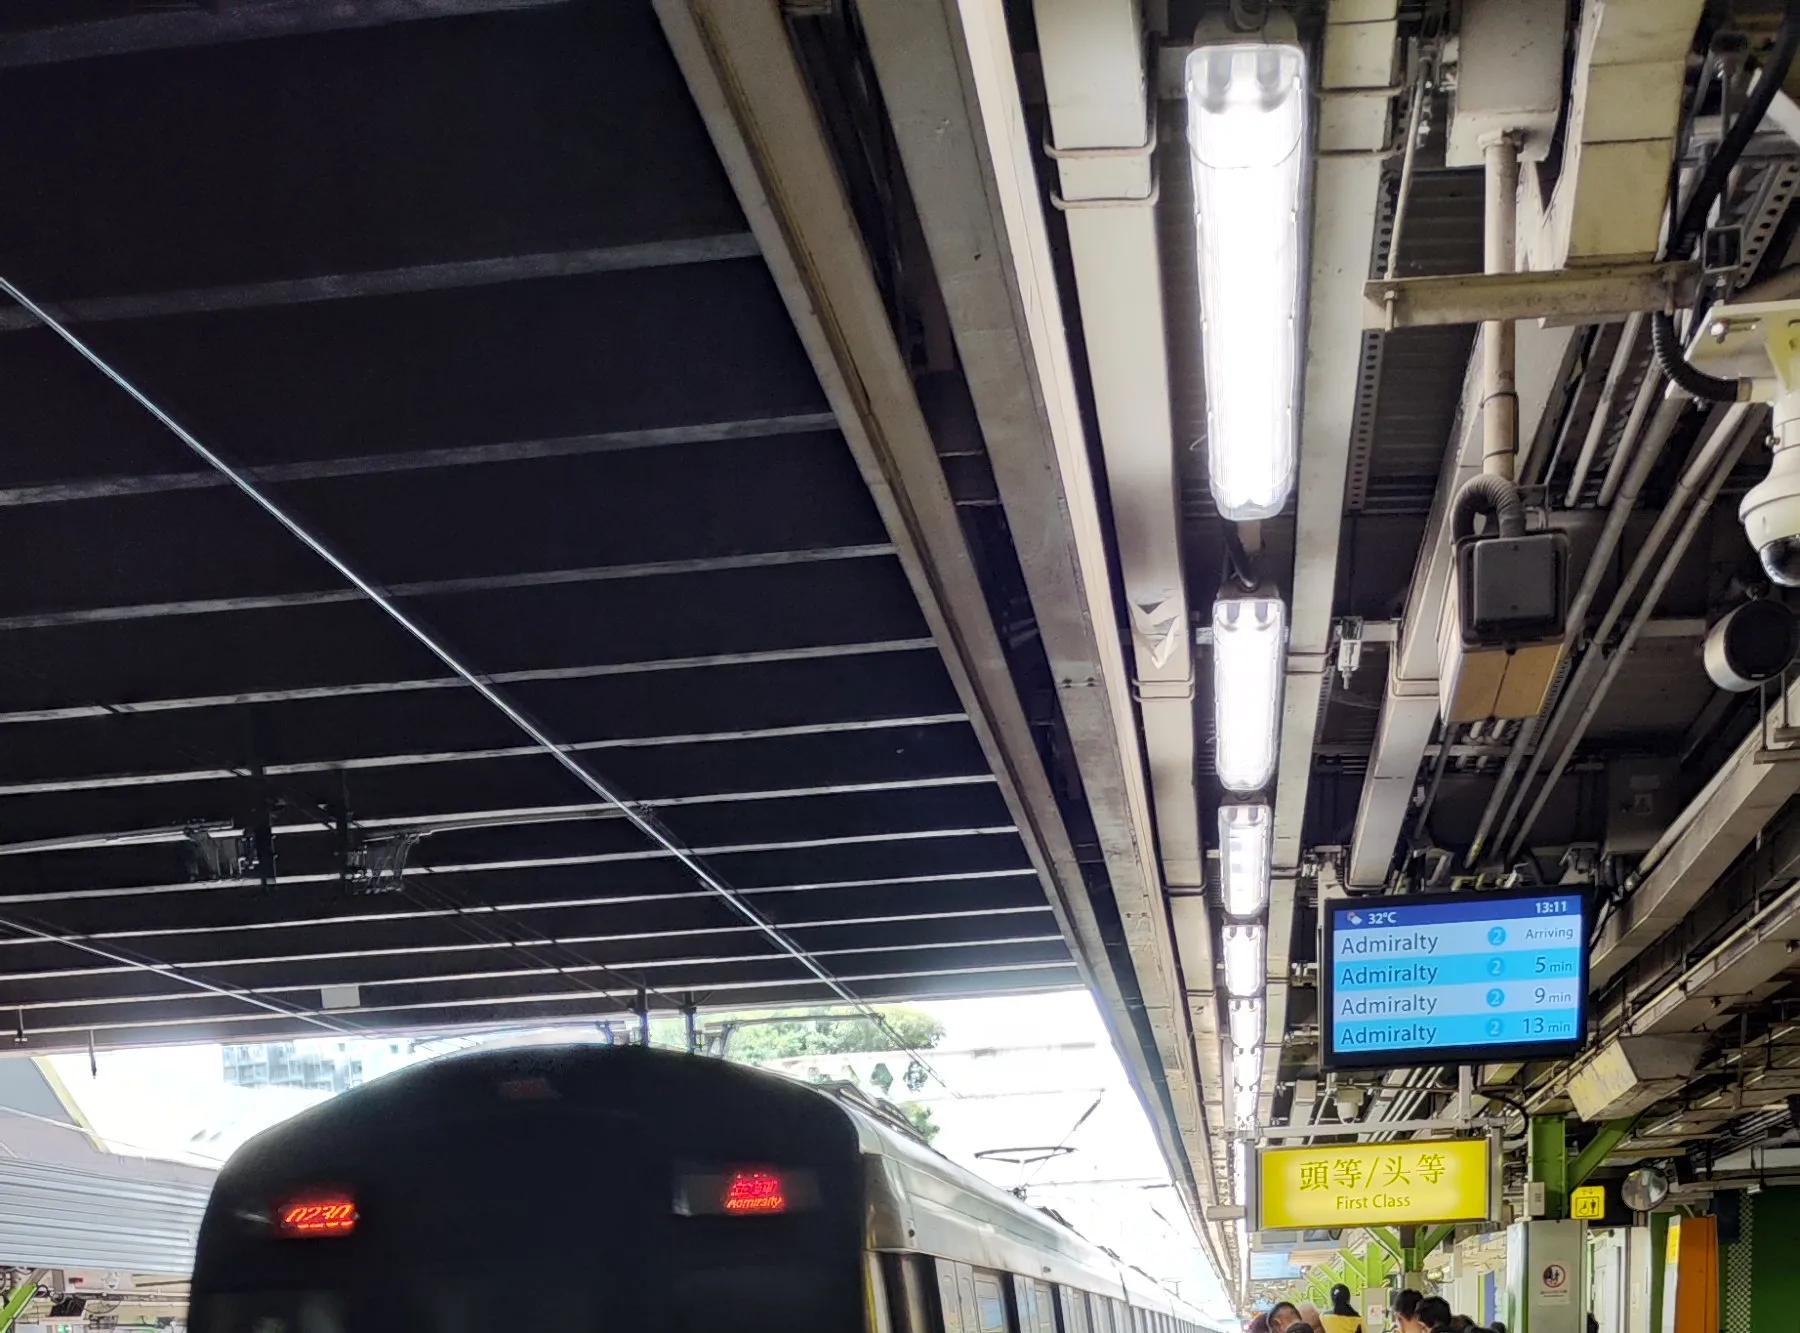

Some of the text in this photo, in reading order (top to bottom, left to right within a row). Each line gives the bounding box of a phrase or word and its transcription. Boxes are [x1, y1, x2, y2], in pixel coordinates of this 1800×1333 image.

[1535, 901, 1567, 913] 13:11
[1341, 932, 1438, 955] Admiralty
[1525, 927, 1573, 941] Arriving
[1341, 963, 1438, 985] Admiralty
[1535, 957, 1545, 973] 5
[1550, 962, 1572, 972] min
[1341, 994, 1438, 1016] Admiralty
[1534, 987, 1545, 1003] 9
[1549, 993, 1571, 1003] min
[1341, 1025, 1437, 1045] Admiralty
[1522, 1017, 1544, 1034] 13
[1548, 1023, 1571, 1033] min
[1299, 1153, 1446, 1191] 頭等/头等
[1336, 1193, 1411, 1210] First Class
